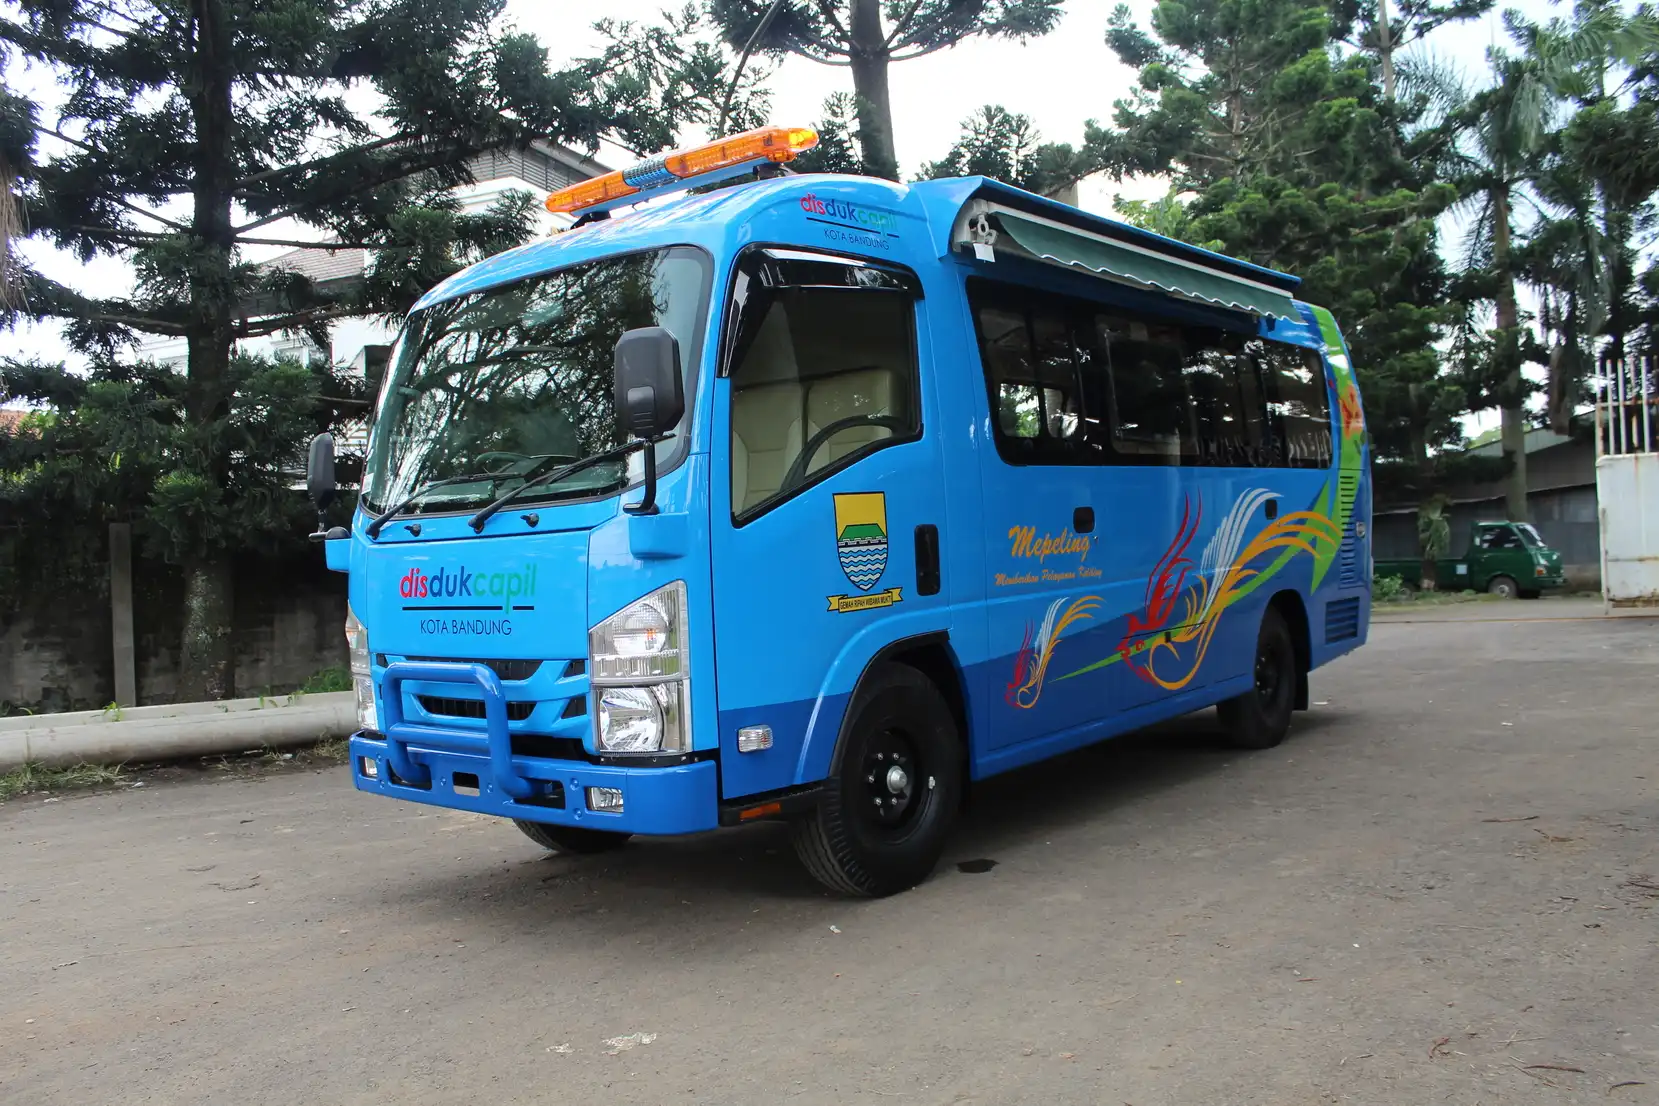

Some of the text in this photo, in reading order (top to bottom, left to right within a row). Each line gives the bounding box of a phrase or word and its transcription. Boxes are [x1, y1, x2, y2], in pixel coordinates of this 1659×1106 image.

[800, 192, 897, 236] disdukcapil
[824, 229, 890, 250] KOTA BANDUNG
[1008, 525, 1090, 564] Mepeling
[400, 563, 537, 614] disdukcapil
[420, 619, 512, 635] KOTA BANDUNG
